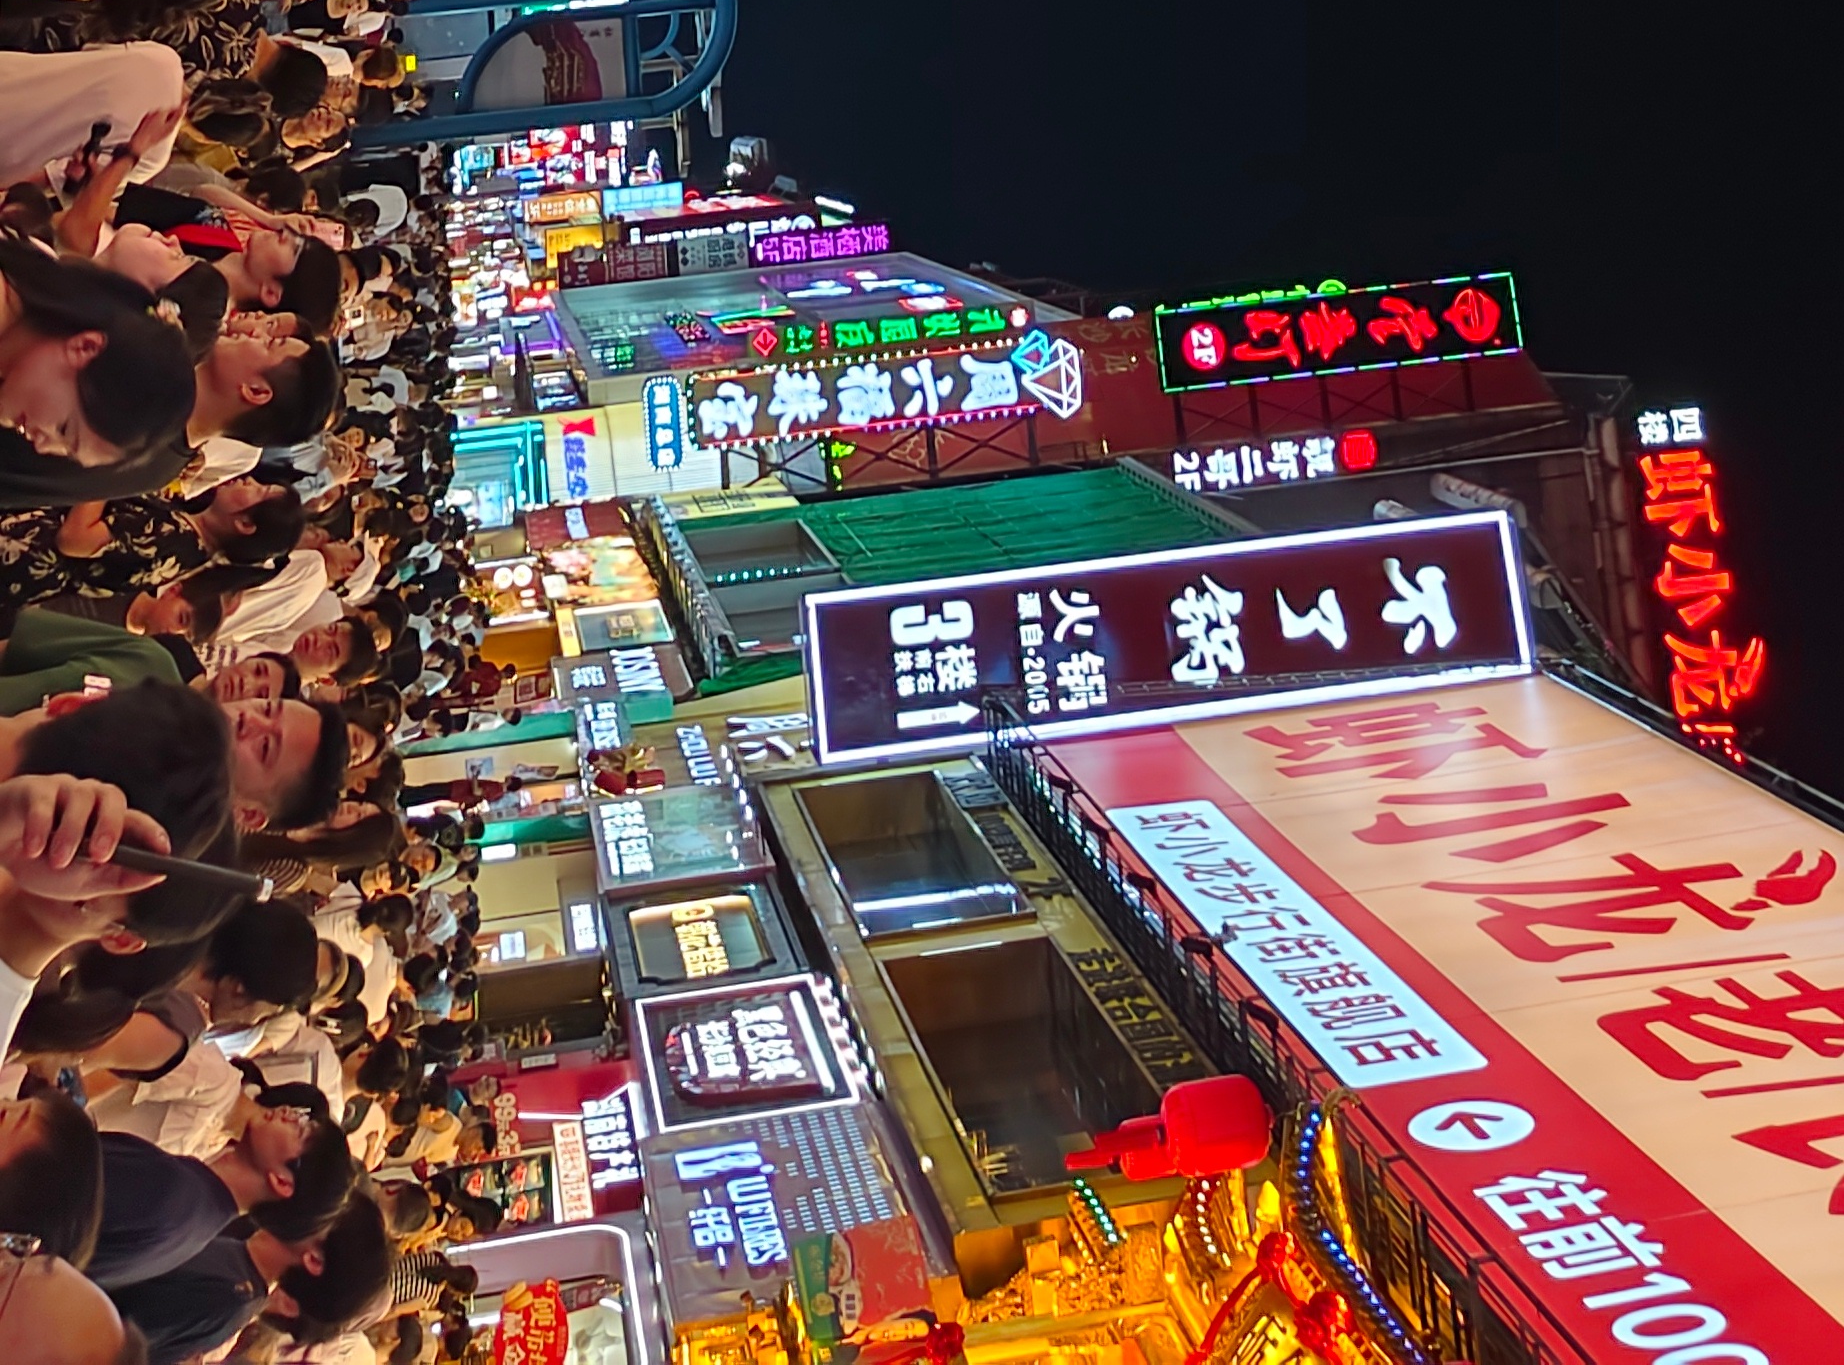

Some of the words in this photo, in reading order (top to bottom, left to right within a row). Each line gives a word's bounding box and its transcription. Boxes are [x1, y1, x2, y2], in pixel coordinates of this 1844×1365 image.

[697, 354, 1019, 439] 周六福珠宝
[1189, 327, 1216, 364] 2F
[1638, 407, 1704, 445] 四楼
[1638, 449, 1776, 715] 虾小龙
[1049, 589, 1108, 712] 火锅
[1135, 809, 1444, 1068] 虾小龙步行街旗舰店
